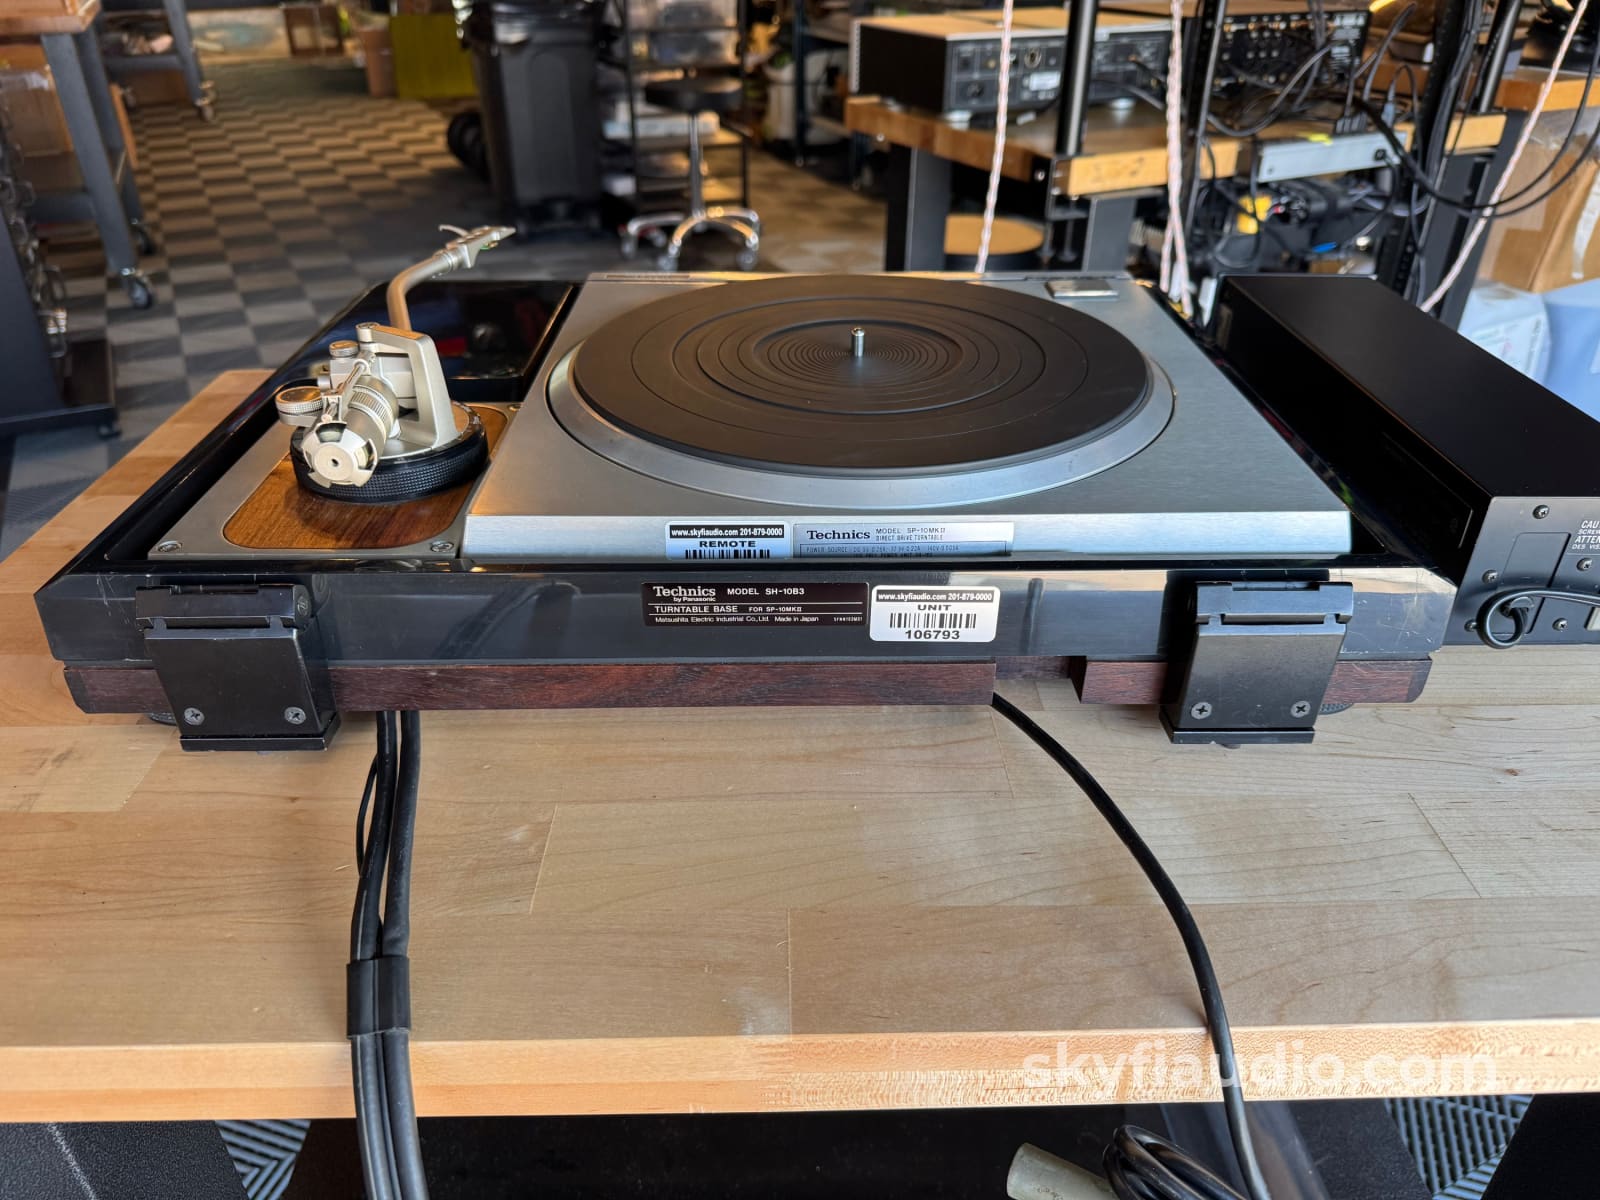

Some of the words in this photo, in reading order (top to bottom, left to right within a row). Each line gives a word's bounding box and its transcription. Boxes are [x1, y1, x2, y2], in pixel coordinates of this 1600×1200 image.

[1581, 520, 1600, 529] CAU
[671, 527, 738, 537] www.skyfiaudio.com
[739, 527, 783, 536] 201-879-0000
[806, 530, 870, 540] Technics
[699, 540, 757, 548] REMOTE
[652, 586, 716, 597] Technics
[727, 587, 760, 595] MODEL
[765, 587, 805, 596] SH-10B3
[878, 592, 947, 602] www.skyfiaudio.com
[948, 592, 993, 601] 201-879-0000
[654, 605, 710, 613] TURNTABLE
[713, 605, 739, 613] BASE
[905, 629, 960, 640] 106793
